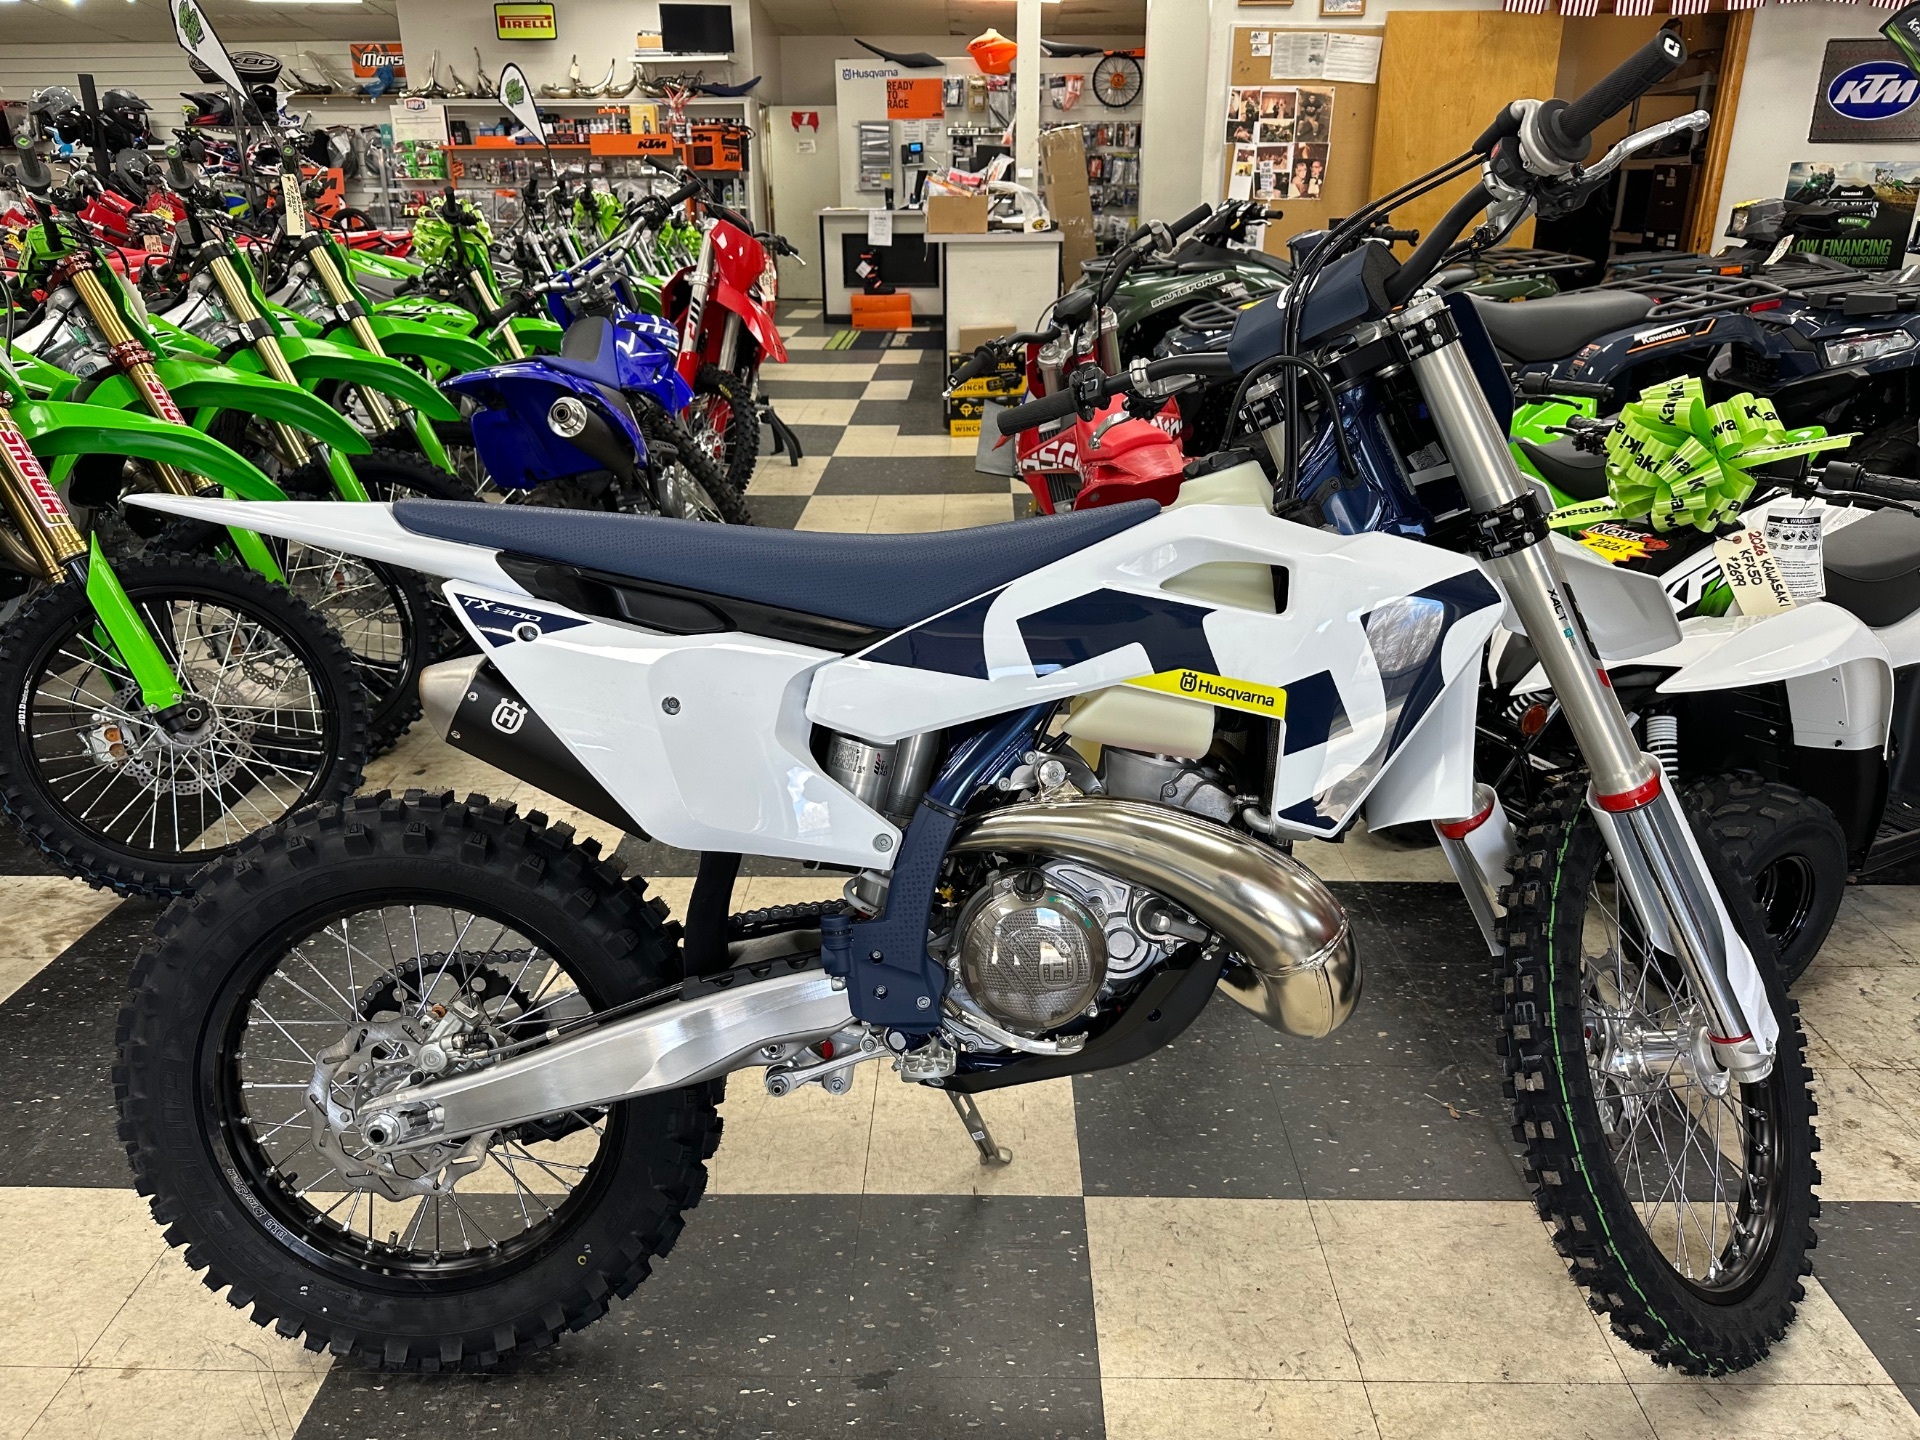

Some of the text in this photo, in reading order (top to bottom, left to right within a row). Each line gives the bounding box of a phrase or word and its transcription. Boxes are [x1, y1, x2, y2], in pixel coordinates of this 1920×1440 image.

[499, 15, 552, 29] PIRELLI
[852, 68, 899, 80] Husqvarna
[886, 81, 914, 90] READY
[1833, 74, 1918, 104] KTM
[887, 91, 898, 99] TO
[406, 100, 425, 110] 100%
[887, 99, 909, 109] RACE
[637, 139, 667, 149] KTM
[1821, 239, 1893, 256] FINANCING
[1641, 327, 1686, 345] Kawasaki
[1589, 538, 1632, 553] 2026!
[1739, 548, 1763, 586] KFX50
[1748, 530, 1791, 607] 2026 KAWASAKI
[1547, 588, 1568, 621] XACT
[1198, 680, 1275, 707] Husqvarna
[264, 1218, 288, 1241] DID
